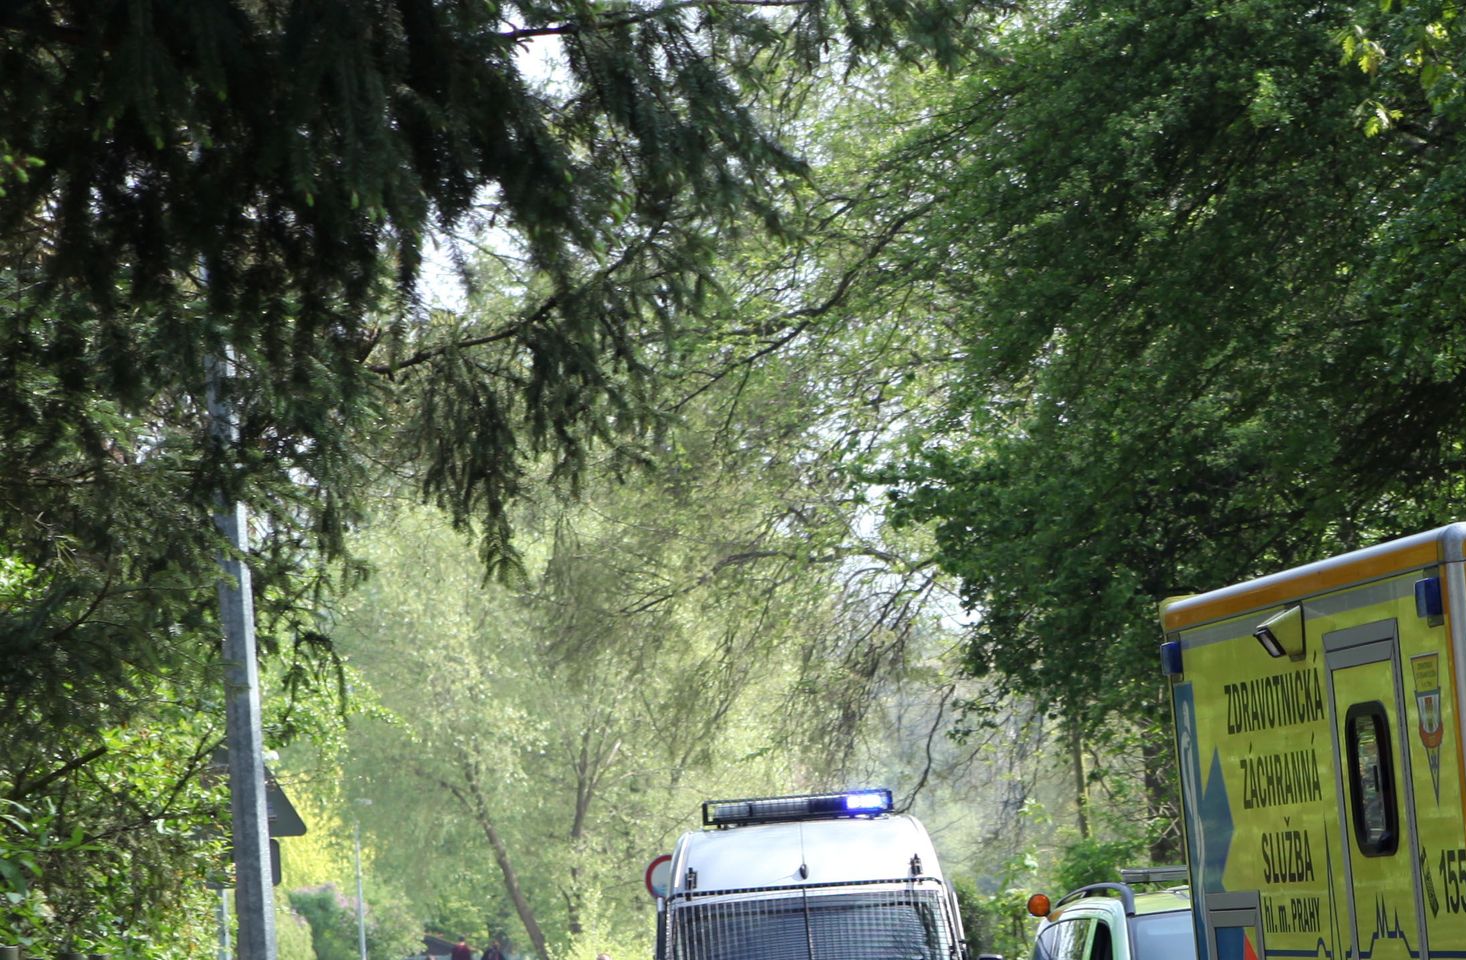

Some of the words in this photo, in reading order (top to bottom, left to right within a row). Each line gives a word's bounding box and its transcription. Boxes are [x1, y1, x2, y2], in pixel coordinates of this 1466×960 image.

[1224, 650, 1325, 735] ZDRAVOTNICKÁ
[1240, 733, 1323, 810] ZÁCHRANNÁ
[1261, 817, 1315, 884] SLUŽBA
[1292, 897, 1321, 933] PRAHY
